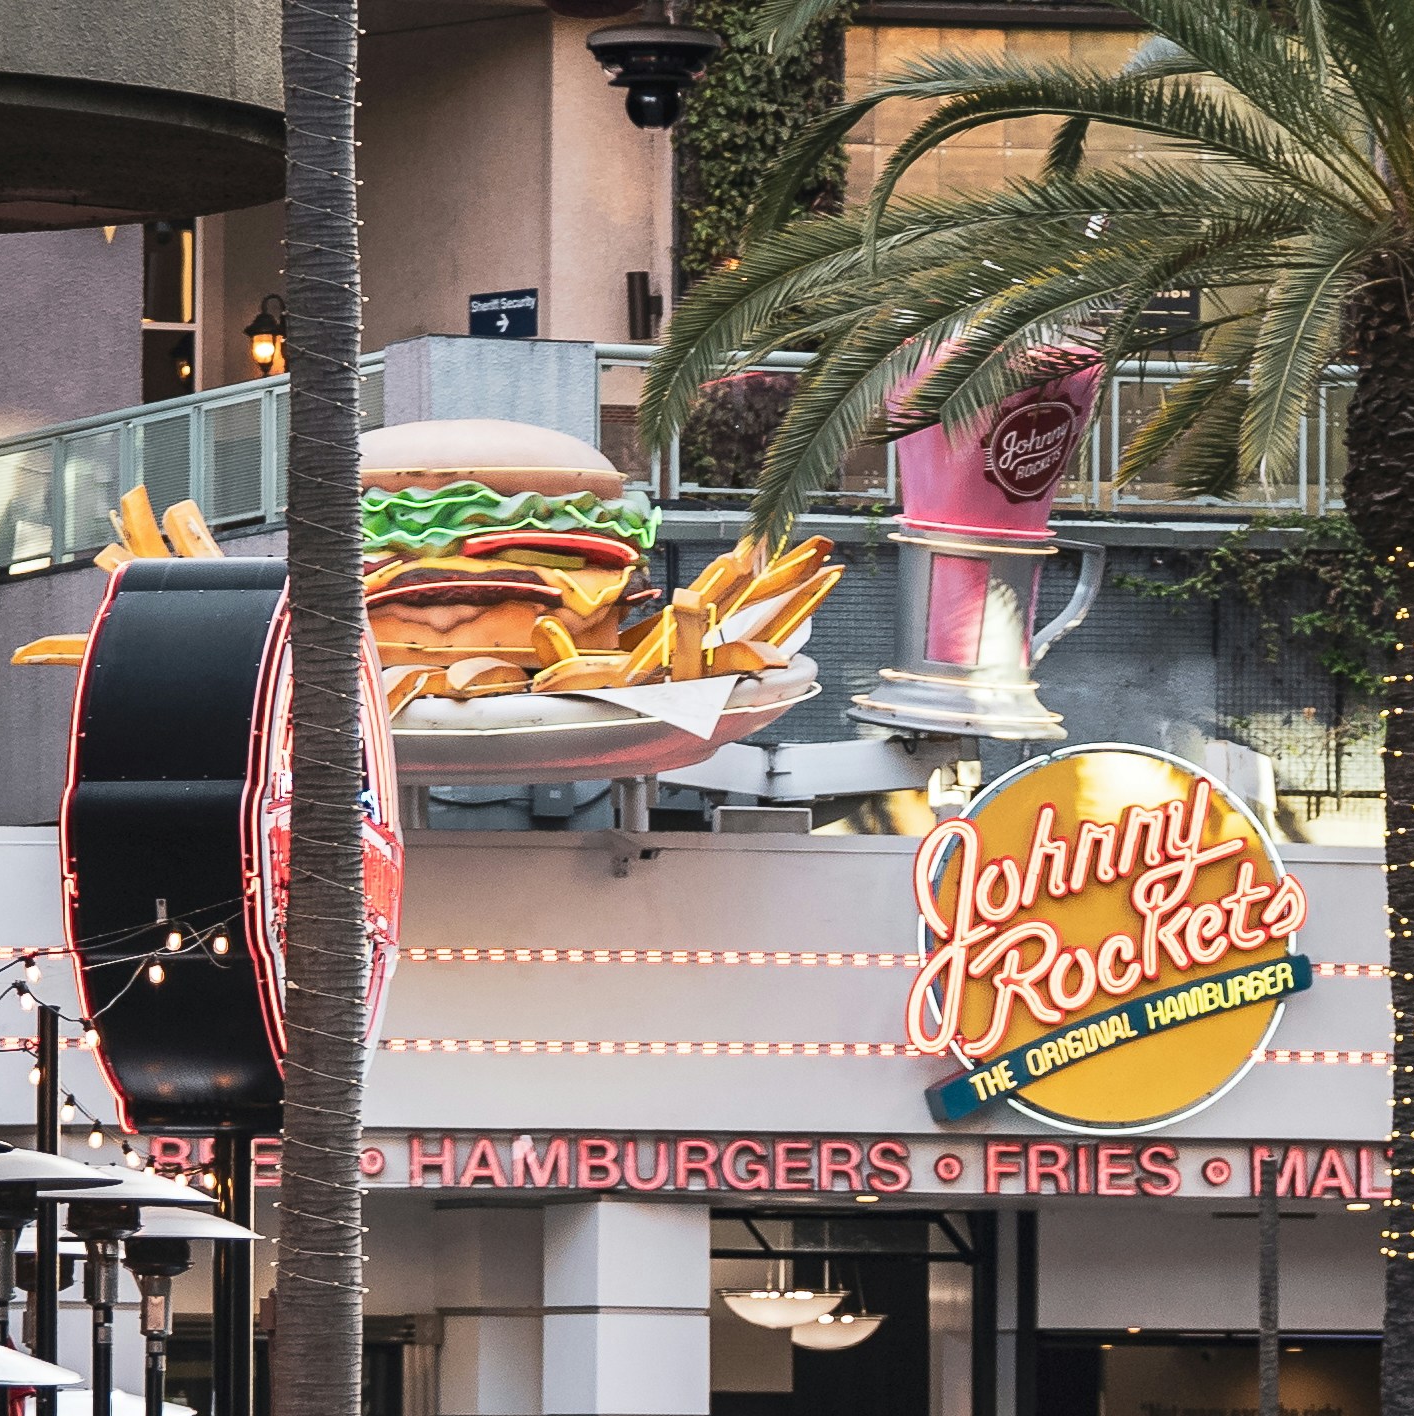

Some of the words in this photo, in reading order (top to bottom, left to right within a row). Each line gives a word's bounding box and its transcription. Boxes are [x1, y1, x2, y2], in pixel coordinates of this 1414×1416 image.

[501, 296, 537, 310] Security
[999, 419, 1071, 470] Johnny
[907, 777, 1248, 1056] Johnny
[963, 860, 1308, 1057] Rockets
[969, 1060, 1017, 1102] THE
[1026, 1012, 1137, 1074] ORIGINAL
[1145, 963, 1295, 1029] HAMBURGER
[409, 1135, 912, 1193] HAMBURGERS
[985, 1142, 1182, 1197] FRIES
[1251, 1146, 1394, 1199] MAL
